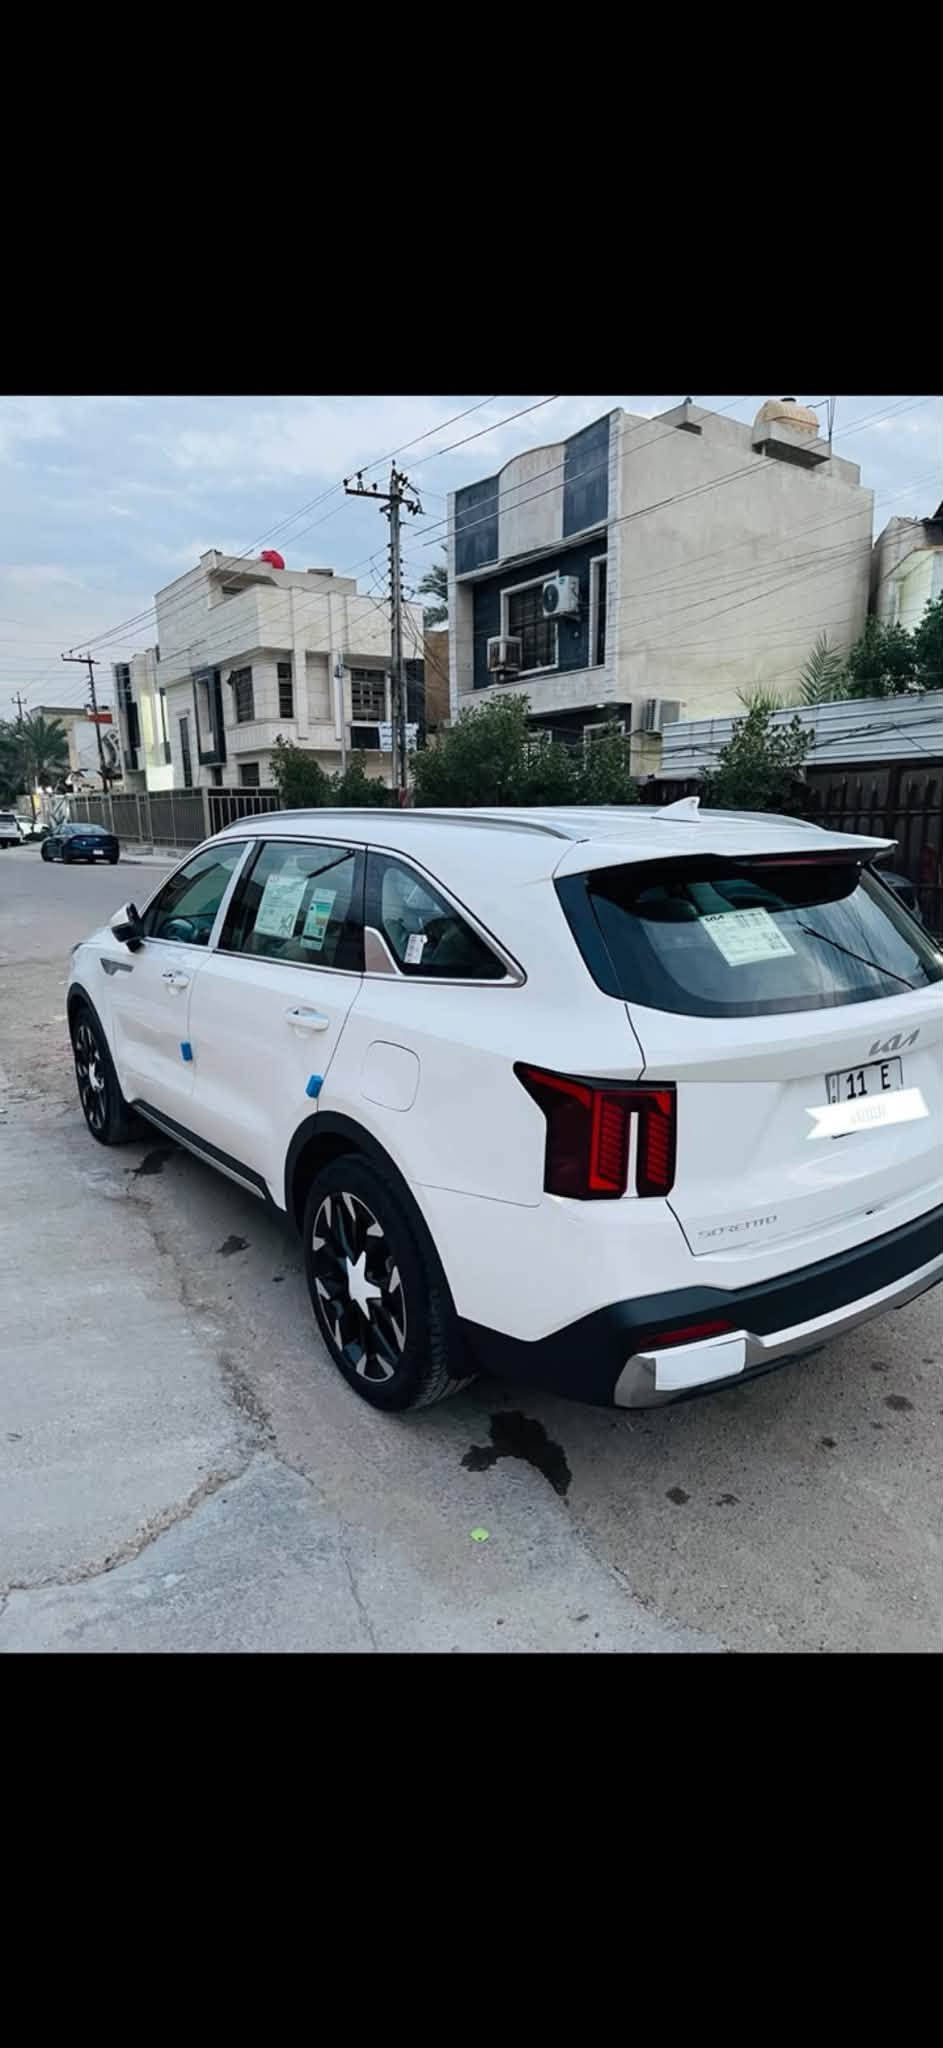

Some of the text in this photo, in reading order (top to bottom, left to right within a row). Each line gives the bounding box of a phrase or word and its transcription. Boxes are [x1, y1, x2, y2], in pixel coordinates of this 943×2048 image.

[846, 1071, 868, 1100] 11
[880, 1064, 891, 1090] E
[698, 1215, 778, 1239] SORENTO
